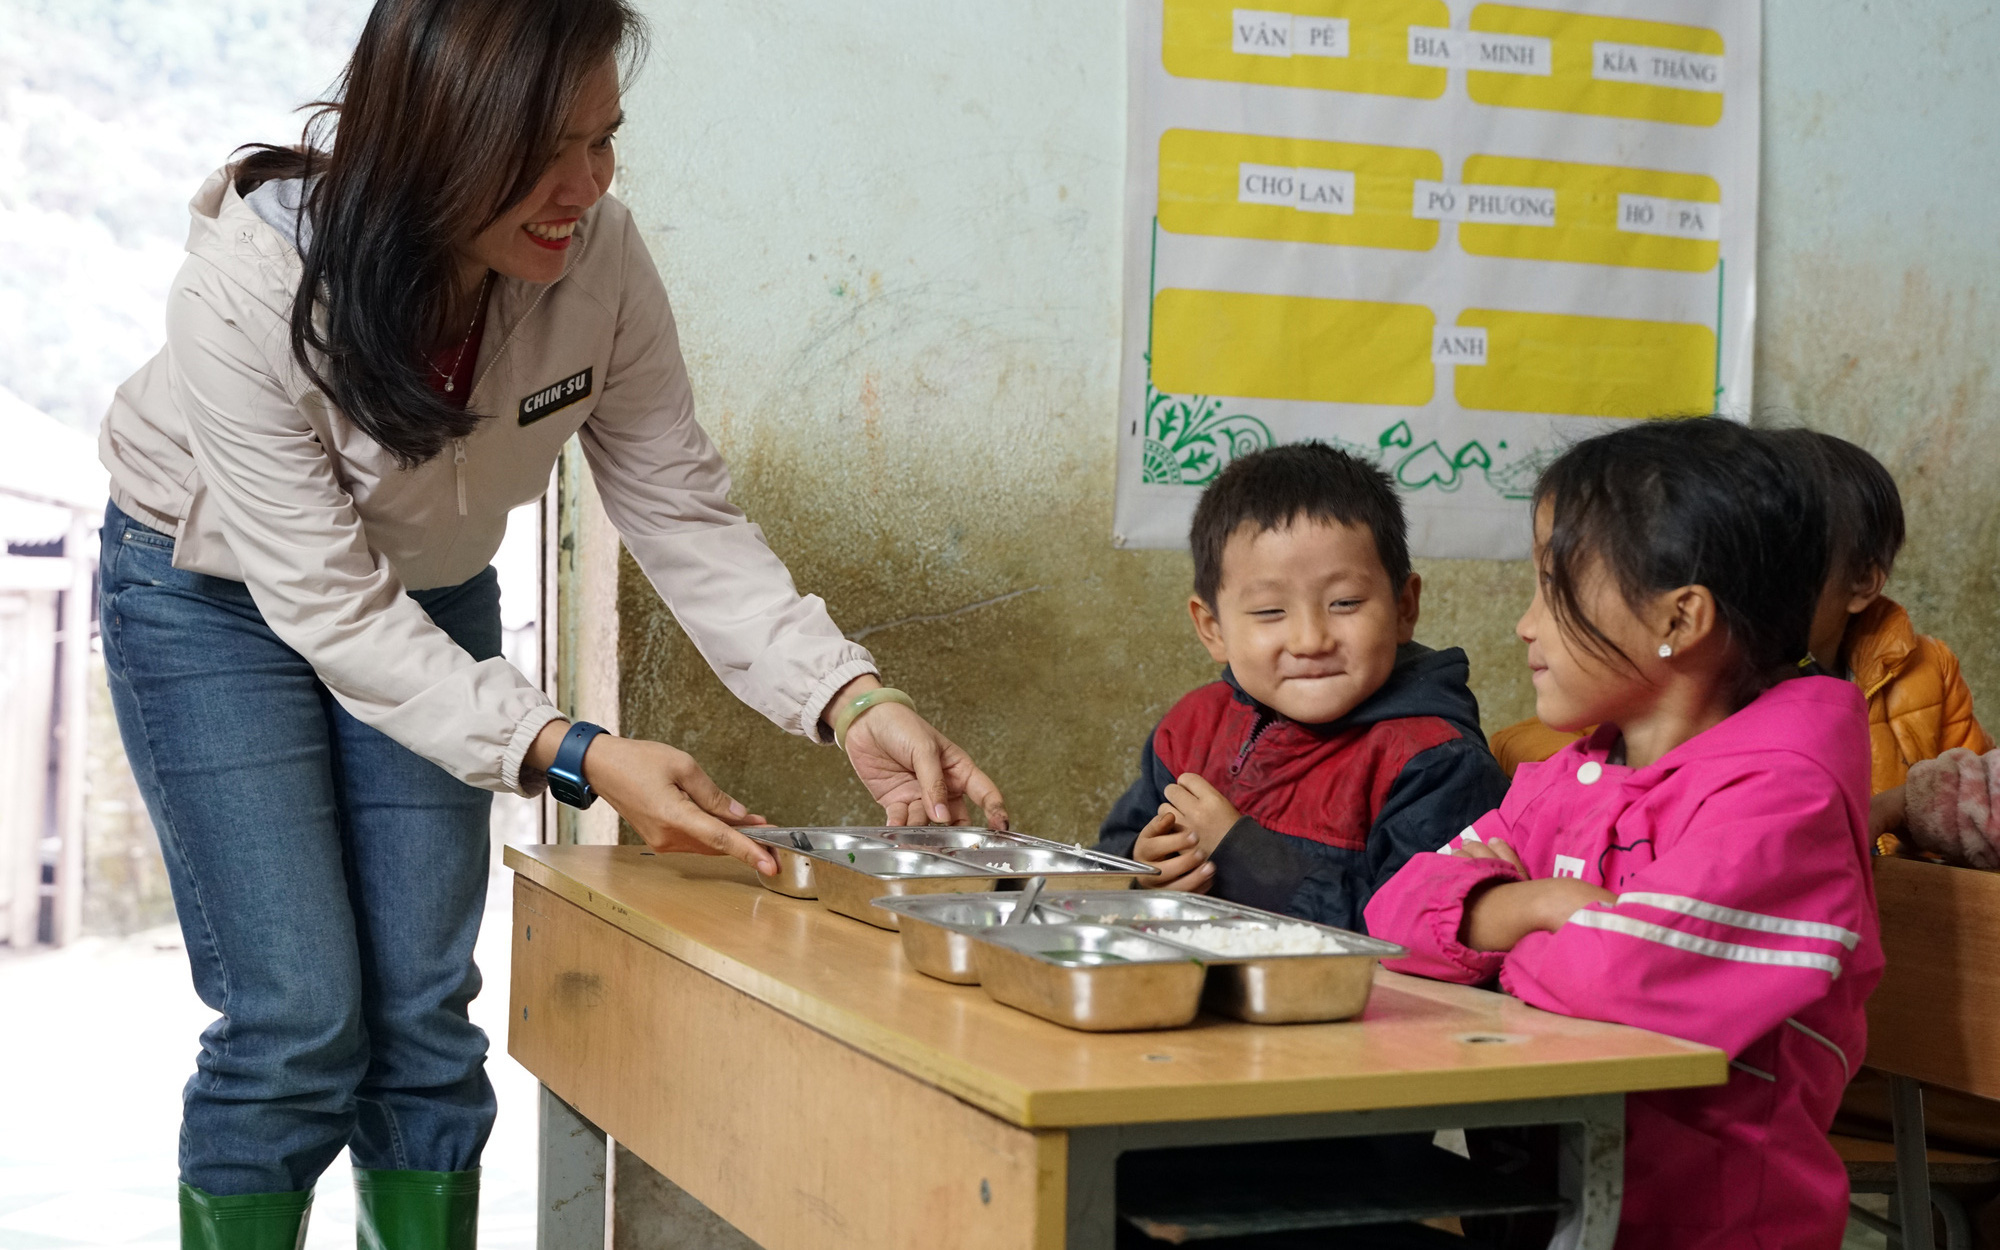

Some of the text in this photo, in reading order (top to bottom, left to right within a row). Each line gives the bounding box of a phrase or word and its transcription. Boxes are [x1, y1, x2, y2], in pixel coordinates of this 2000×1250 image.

[1479, 42, 1535, 66] MINH
[1299, 182, 1344, 204] LAN
[1468, 193, 1556, 218] PHƯƠNG
[1437, 336, 1484, 356] ANH
[523, 373, 586, 413] CHIN-SU
